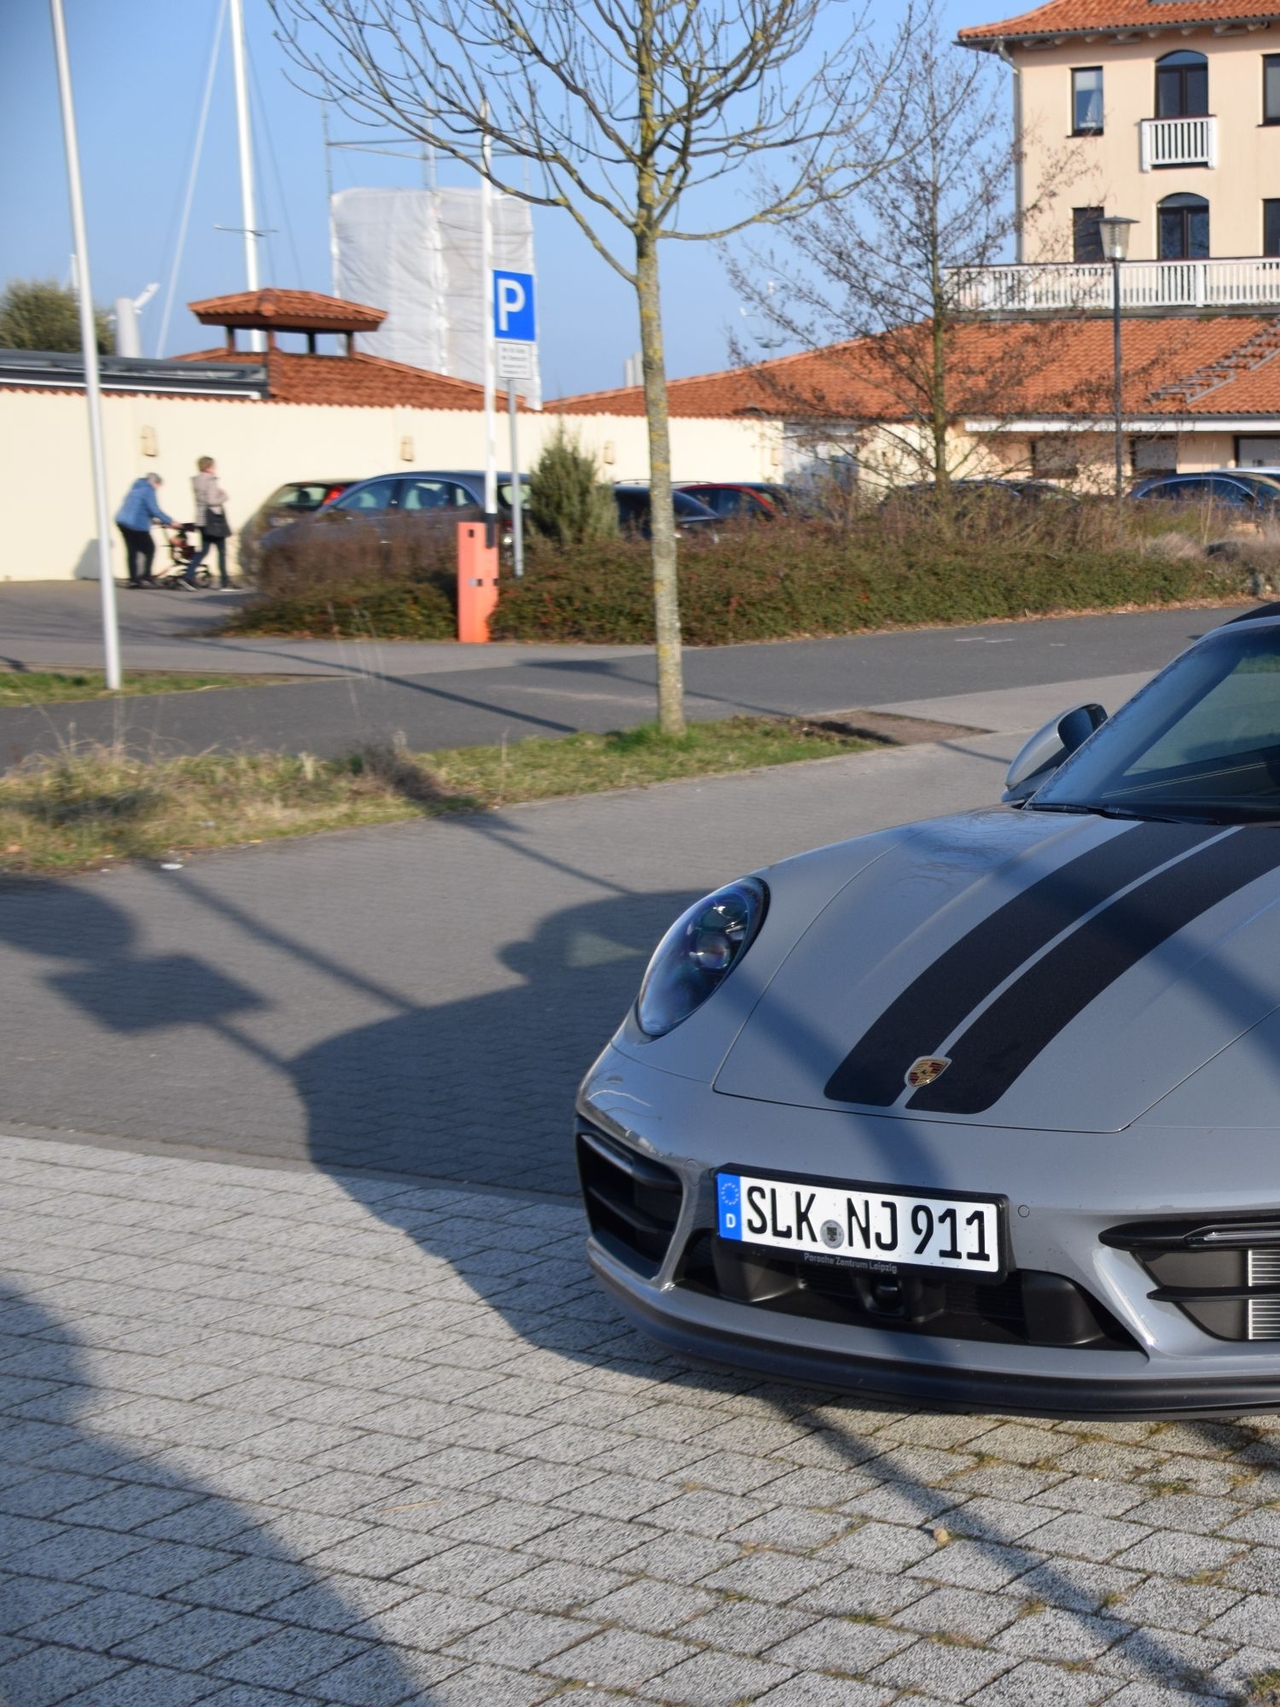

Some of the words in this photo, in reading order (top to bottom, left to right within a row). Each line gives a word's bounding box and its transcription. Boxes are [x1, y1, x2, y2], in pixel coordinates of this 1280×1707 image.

[497, 278, 525, 331] P
[726, 1213, 736, 1229] D
[746, 1185, 818, 1243] SLK
[846, 1197, 898, 1252] NJ
[911, 1204, 991, 1262] 911
[803, 1252, 834, 1265] Porsche
[835, 1256, 868, 1269] Zentrum
[869, 1260, 897, 1274] Leipzig
